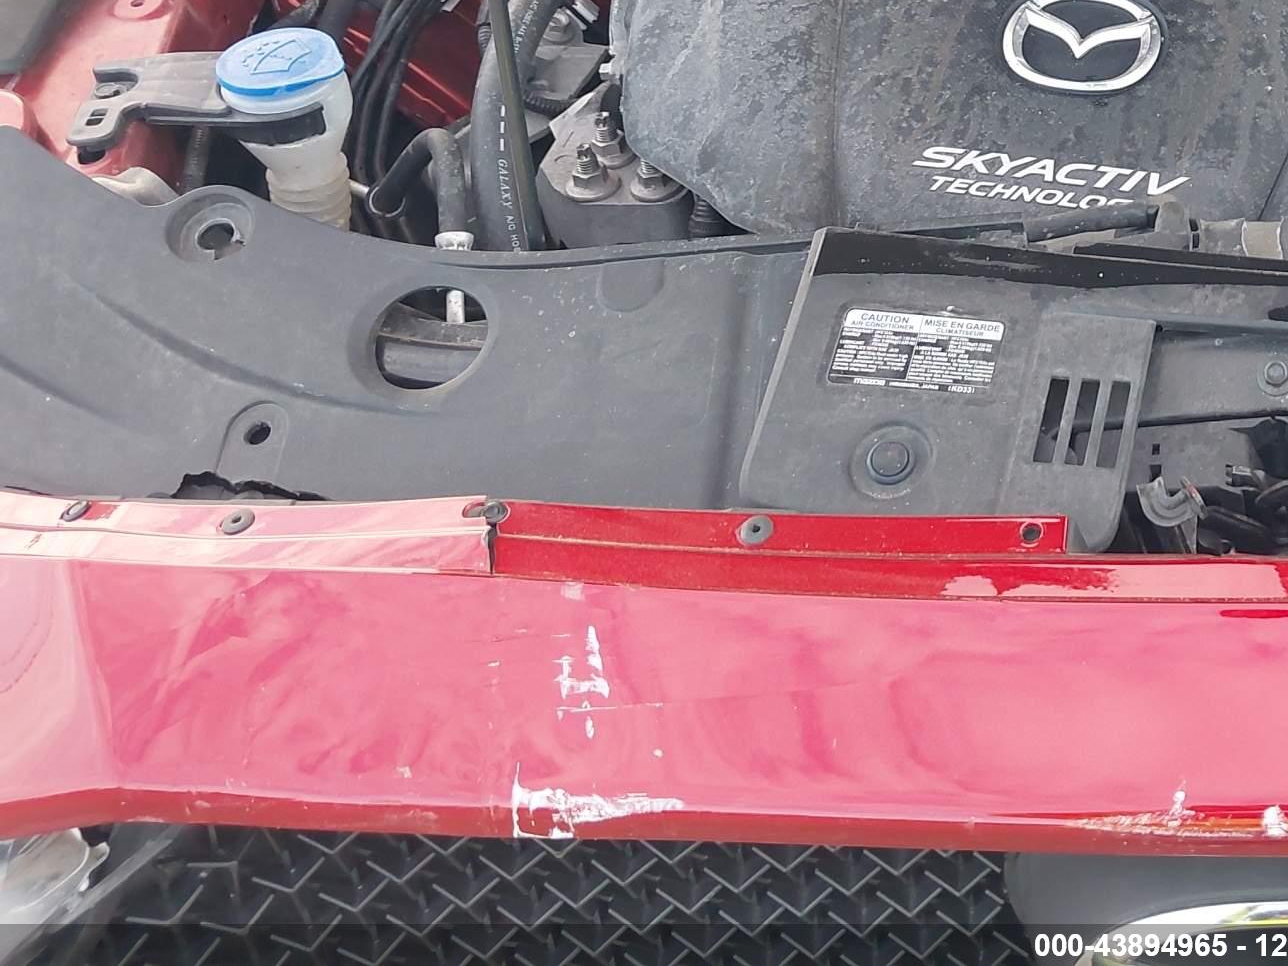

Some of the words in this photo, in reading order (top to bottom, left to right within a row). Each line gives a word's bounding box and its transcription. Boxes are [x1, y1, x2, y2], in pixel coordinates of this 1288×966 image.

[912, 146, 1192, 196] SKYACTIV
[498, 159, 513, 209] GALAXY
[861, 313, 910, 324] CAUTION
[864, 321, 915, 331] CONDITIONER
[924, 319, 949, 328] MISE
[950, 321, 965, 330] EN
[965, 322, 1001, 333] GARDE
